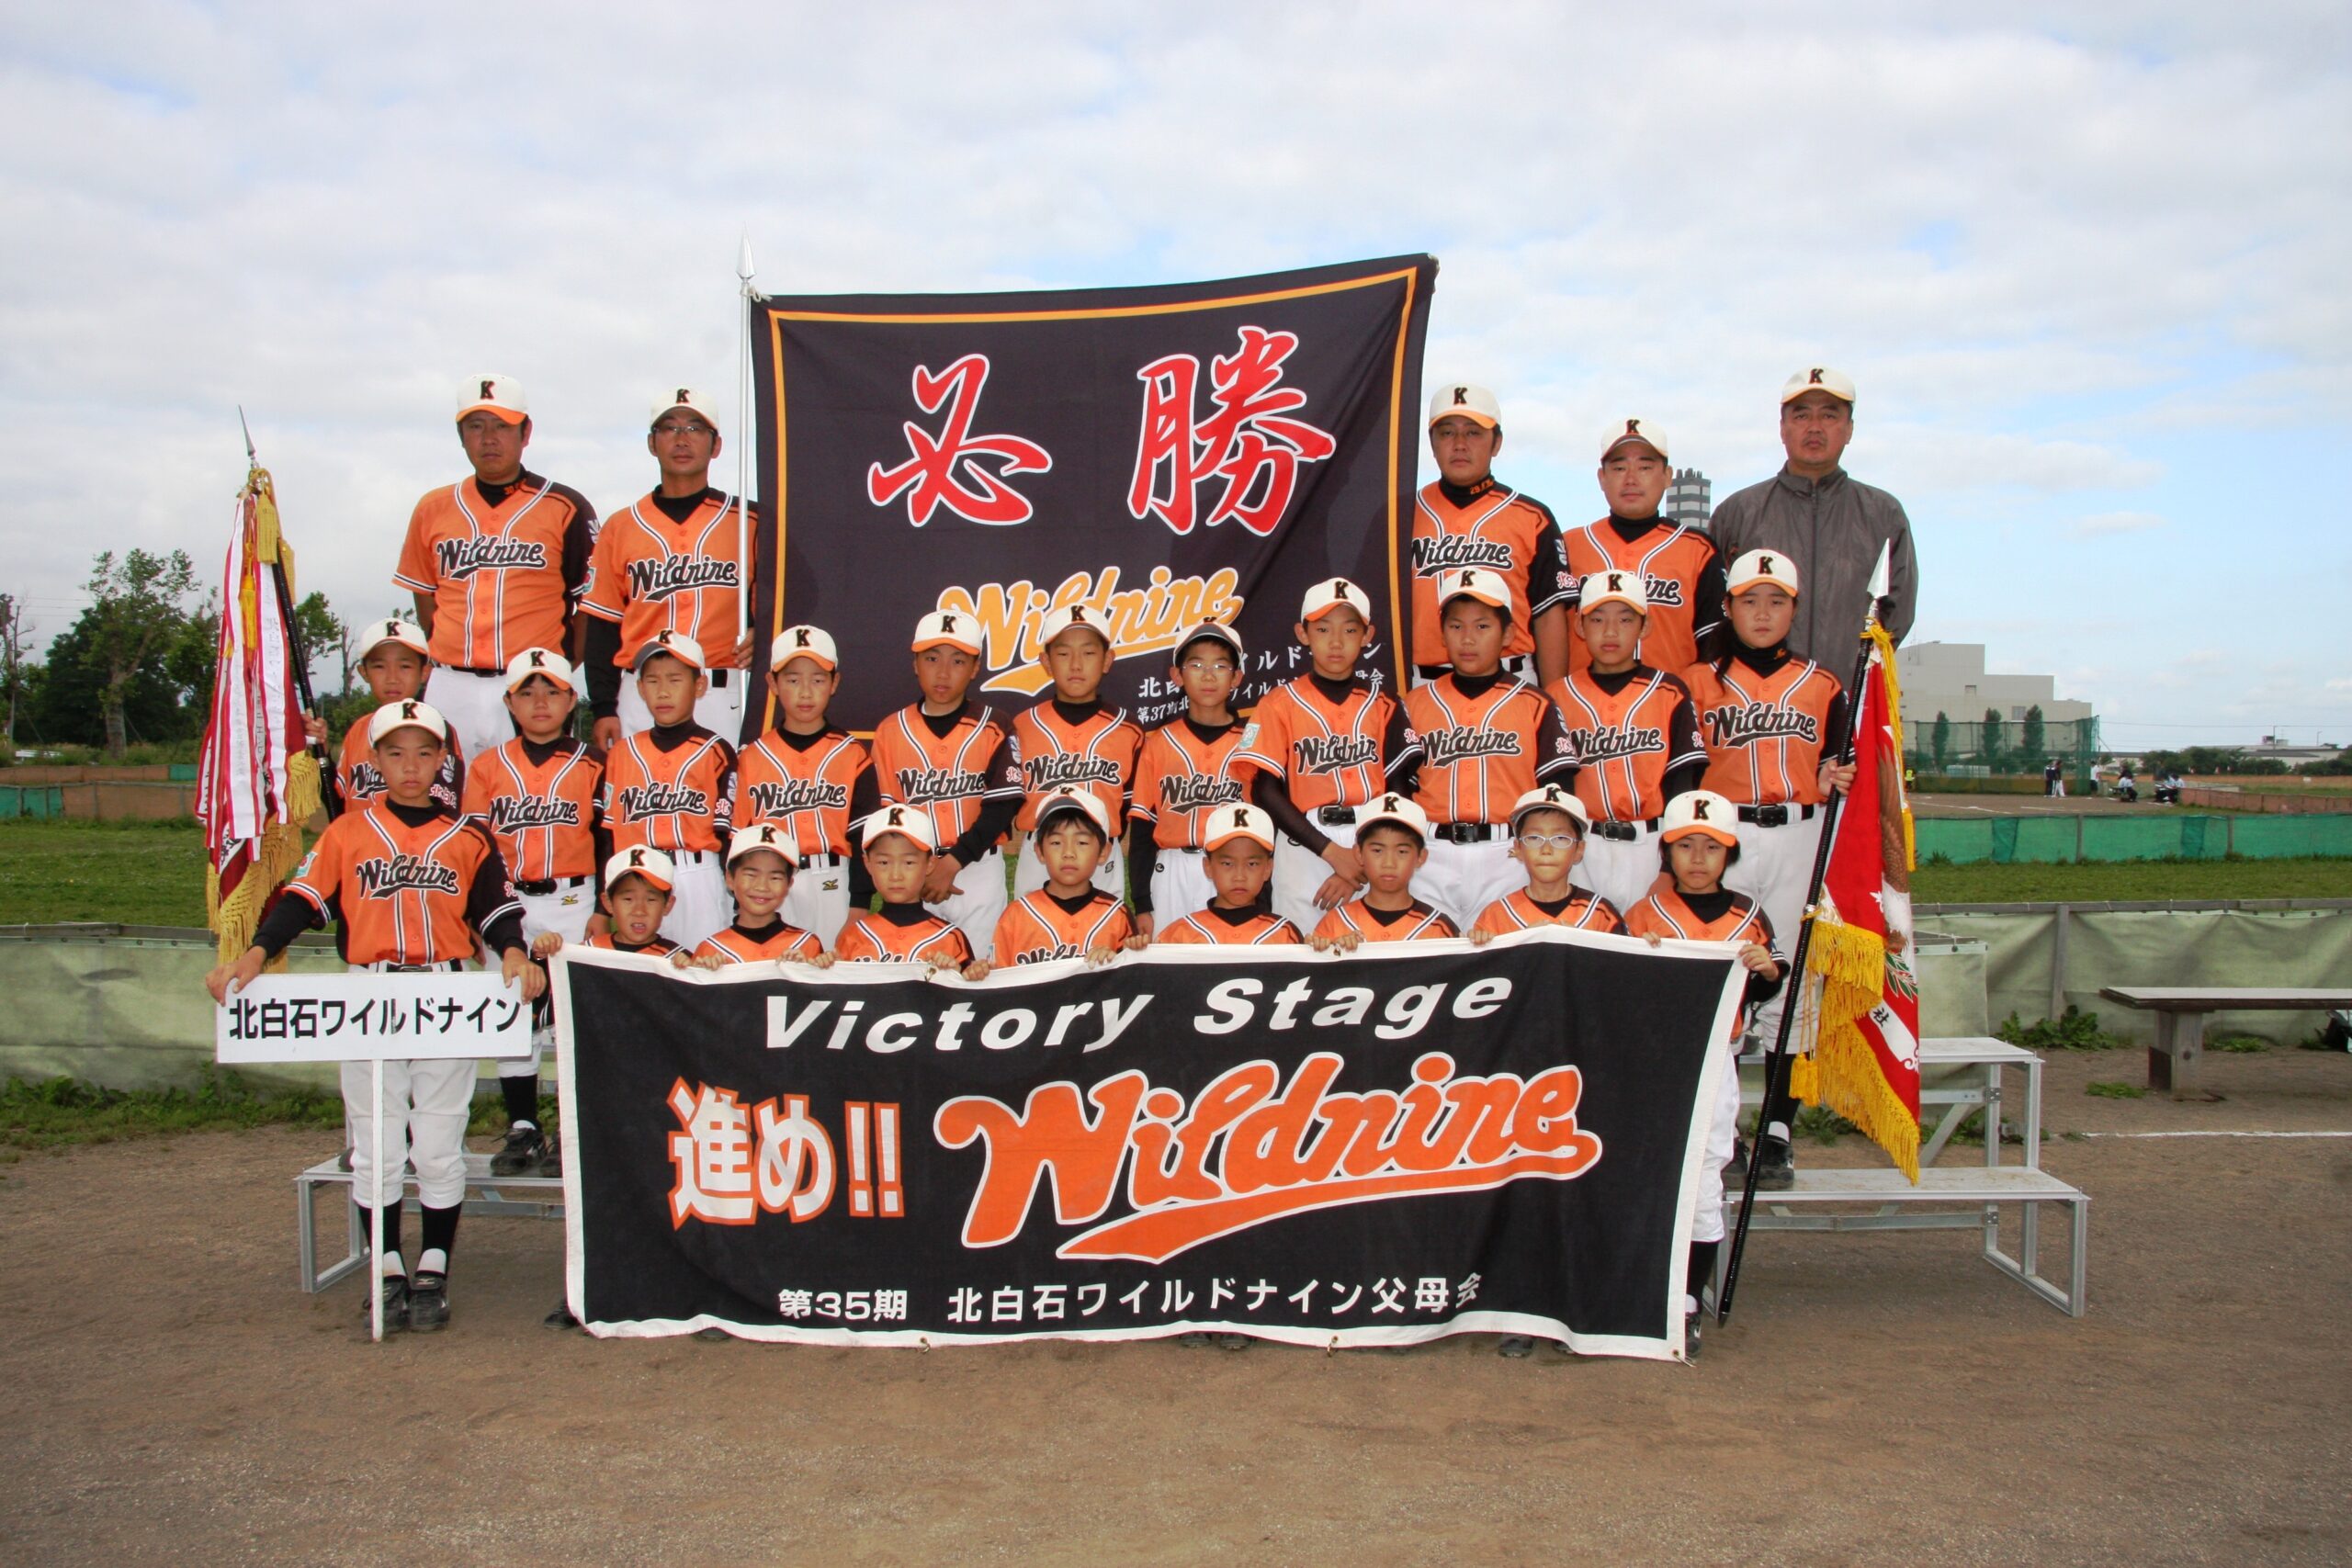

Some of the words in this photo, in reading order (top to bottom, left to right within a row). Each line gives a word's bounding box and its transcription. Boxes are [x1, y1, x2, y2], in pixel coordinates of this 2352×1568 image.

[1809, 368, 1824, 384] K
[479, 380, 494, 400] K
[676, 389, 690, 403] K
[1453, 387, 1467, 405] K
[867, 325, 1336, 536] 必勝
[1626, 419, 1640, 434] K
[436, 535, 548, 581] Wildnine
[1758, 556, 1773, 575] K
[628, 553, 741, 604] Wildnine
[1461, 570, 1476, 587] K
[1608, 574, 1623, 592] K
[1334, 581, 1349, 599] K
[1070, 605, 1085, 622] K
[387, 622, 400, 637] K
[942, 615, 956, 633] K
[659, 629, 673, 644] K
[796, 629, 810, 647] K
[531, 651, 545, 667] K
[402, 702, 418, 720] K
[1704, 701, 1818, 749] Wildnine
[1421, 726, 1521, 767] Wildnine
[1023, 752, 1122, 794] Wildnine
[896, 766, 986, 807] Wildnine
[1545, 786, 1562, 802] K
[619, 782, 709, 824] Wildnine
[749, 779, 847, 821] Wildnine
[1383, 795, 1398, 813] K
[1693, 799, 1709, 819] K
[489, 794, 581, 836] Wildnine
[888, 807, 903, 826] K
[1234, 808, 1249, 828] K
[762, 827, 776, 843] K
[630, 849, 644, 866] K
[356, 852, 461, 900] Wildnine
[229, 996, 521, 1041] 北白石ワイルドナイン
[766, 993, 1155, 1054] Victory
[1194, 976, 1512, 1039] Stage
[933, 1051, 1602, 1265] Wildnine
[777, 1288, 909, 1322] 第35期
[947, 1271, 1482, 1325] 北白石ワイルドナイン父母会
